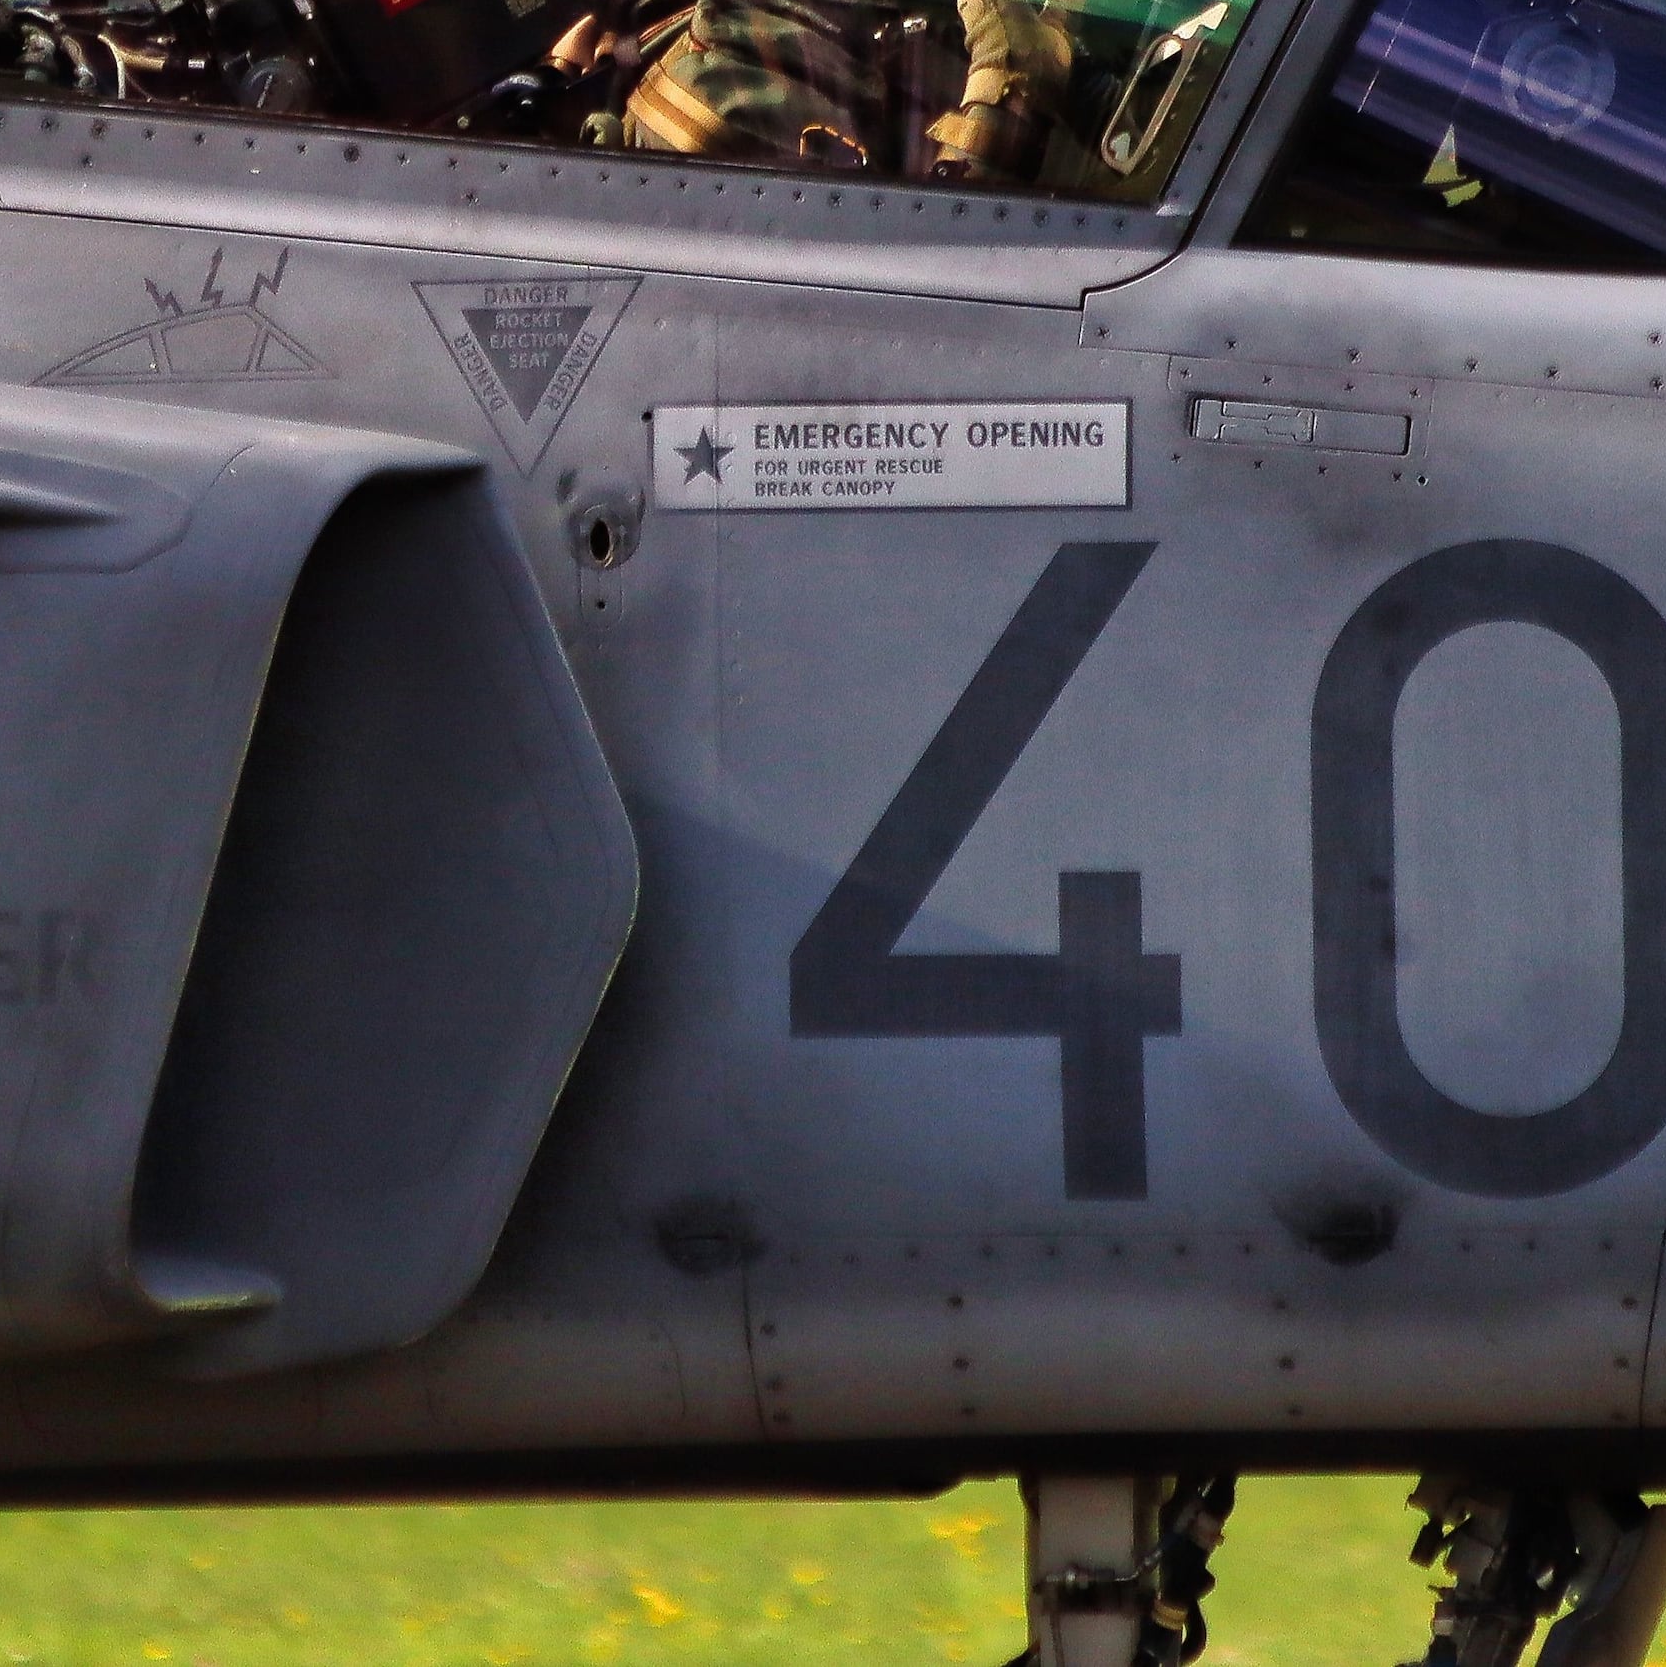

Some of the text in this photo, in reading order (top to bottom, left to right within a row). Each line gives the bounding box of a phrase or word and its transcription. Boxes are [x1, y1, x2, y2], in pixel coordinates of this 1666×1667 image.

[484, 286, 569, 305] DANGER
[494, 312, 564, 330] ROCKET
[488, 332, 569, 350] EJECTION
[508, 353, 550, 370] SEAT
[452, 332, 510, 413] DANGER
[542, 332, 599, 411] DANGER
[753, 420, 1105, 450] EMERGENCY OPENING
[753, 458, 943, 477] FOR URGENT RESCUE
[753, 479, 896, 498] BREAK CANOPY
